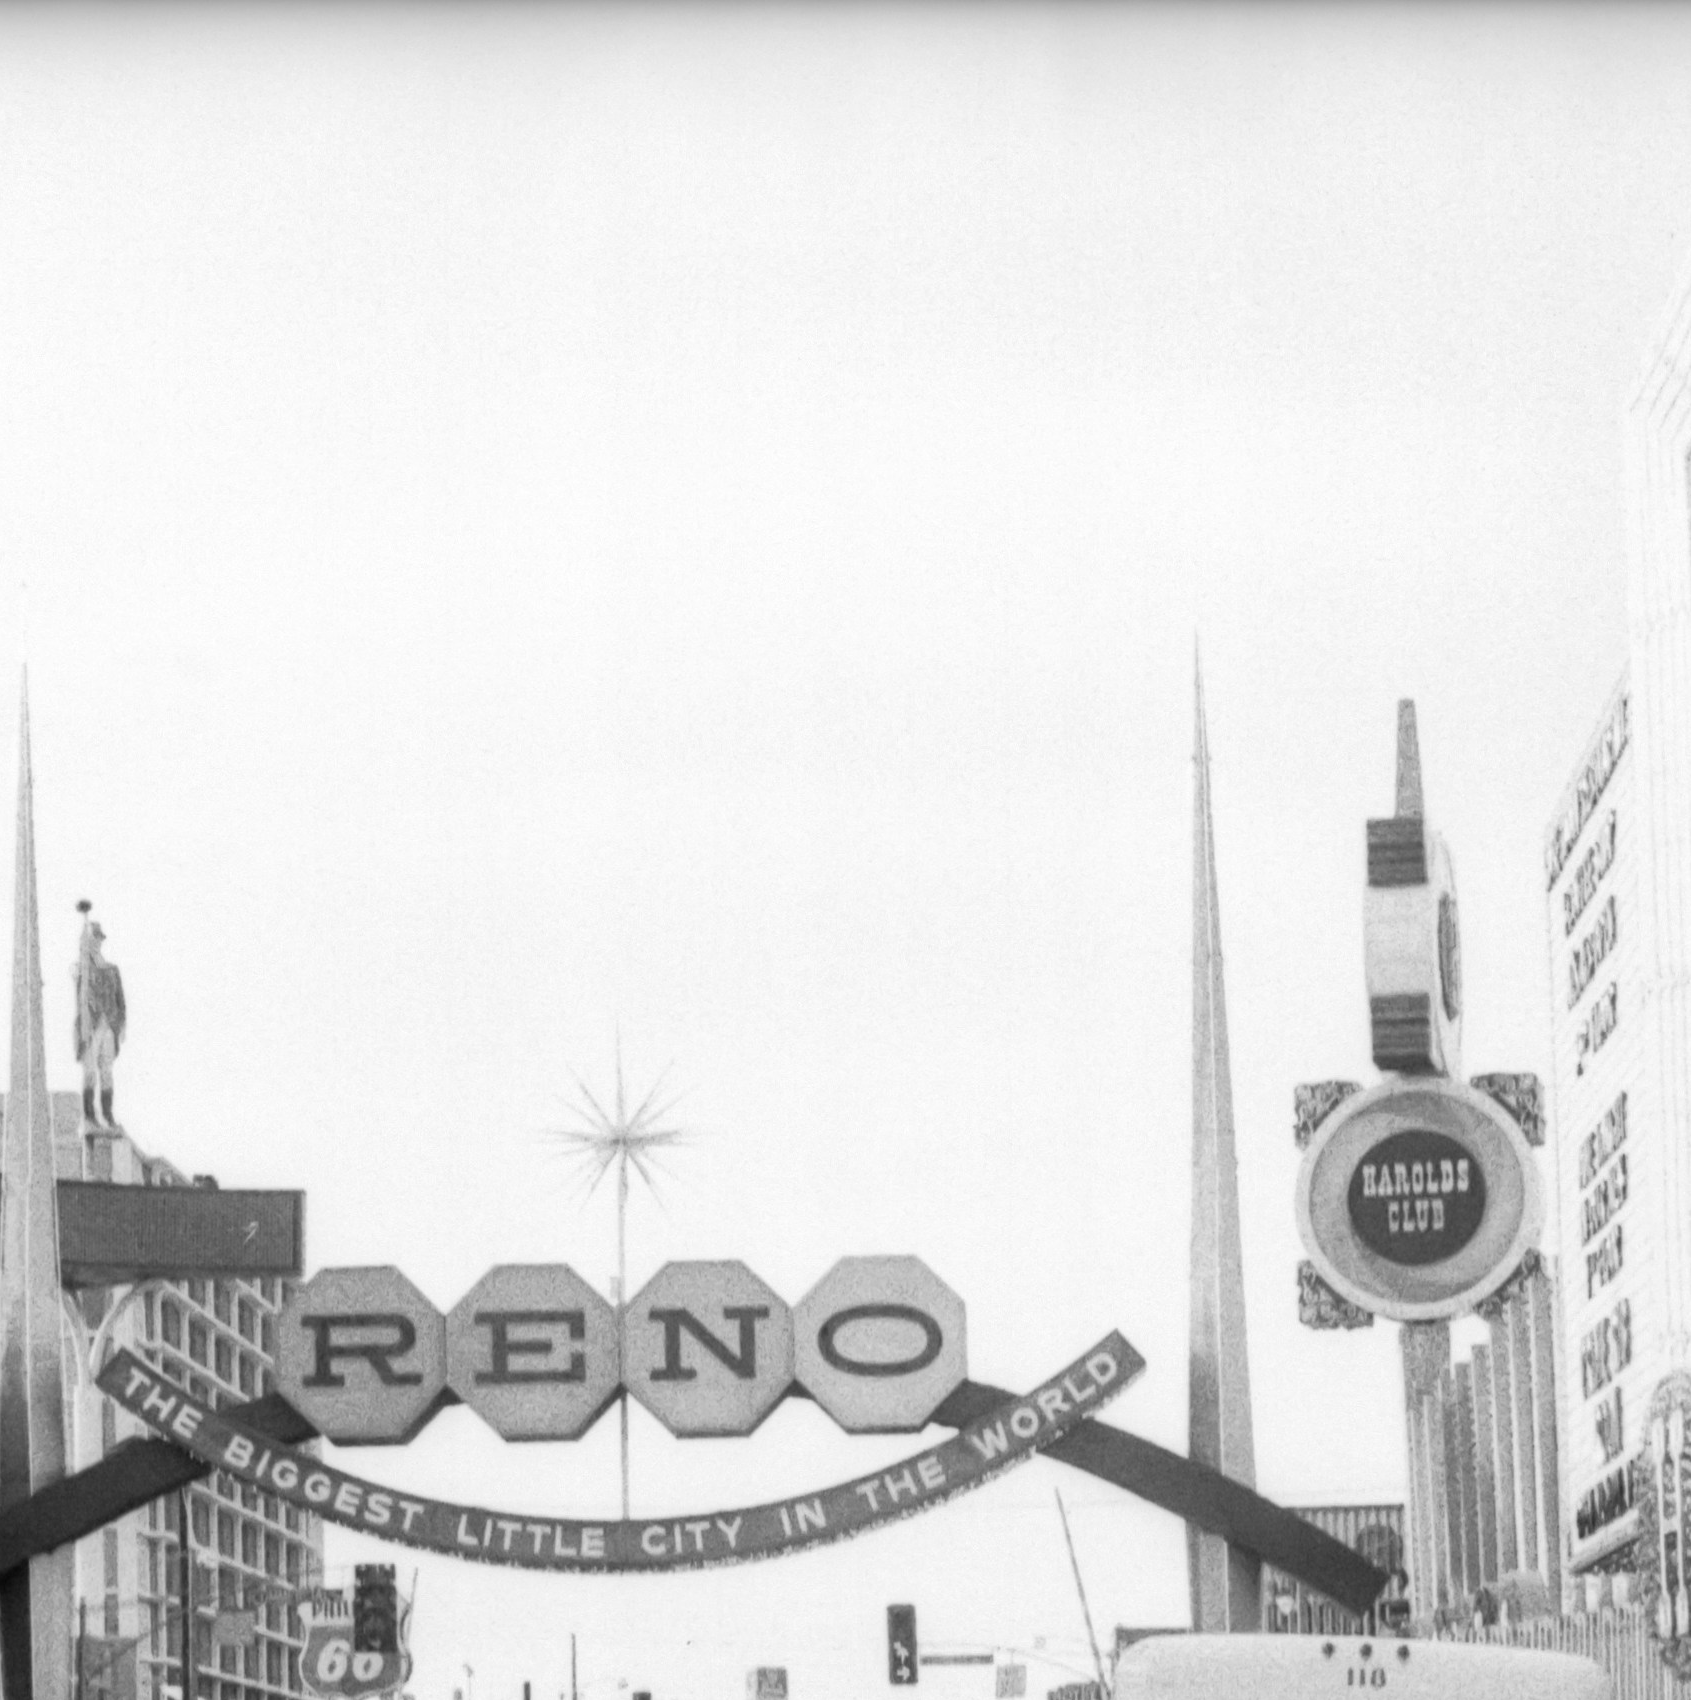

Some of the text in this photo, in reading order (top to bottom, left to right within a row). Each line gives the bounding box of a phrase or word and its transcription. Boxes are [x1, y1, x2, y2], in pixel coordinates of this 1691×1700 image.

[1362, 1158, 1469, 1197] HAROLDS
[1388, 1198, 1445, 1233] CLUB
[299, 1302, 944, 1388] RENO
[124, 1350, 1119, 1558] THE BIGGEST LITTLE CITY IN THE WORLD
